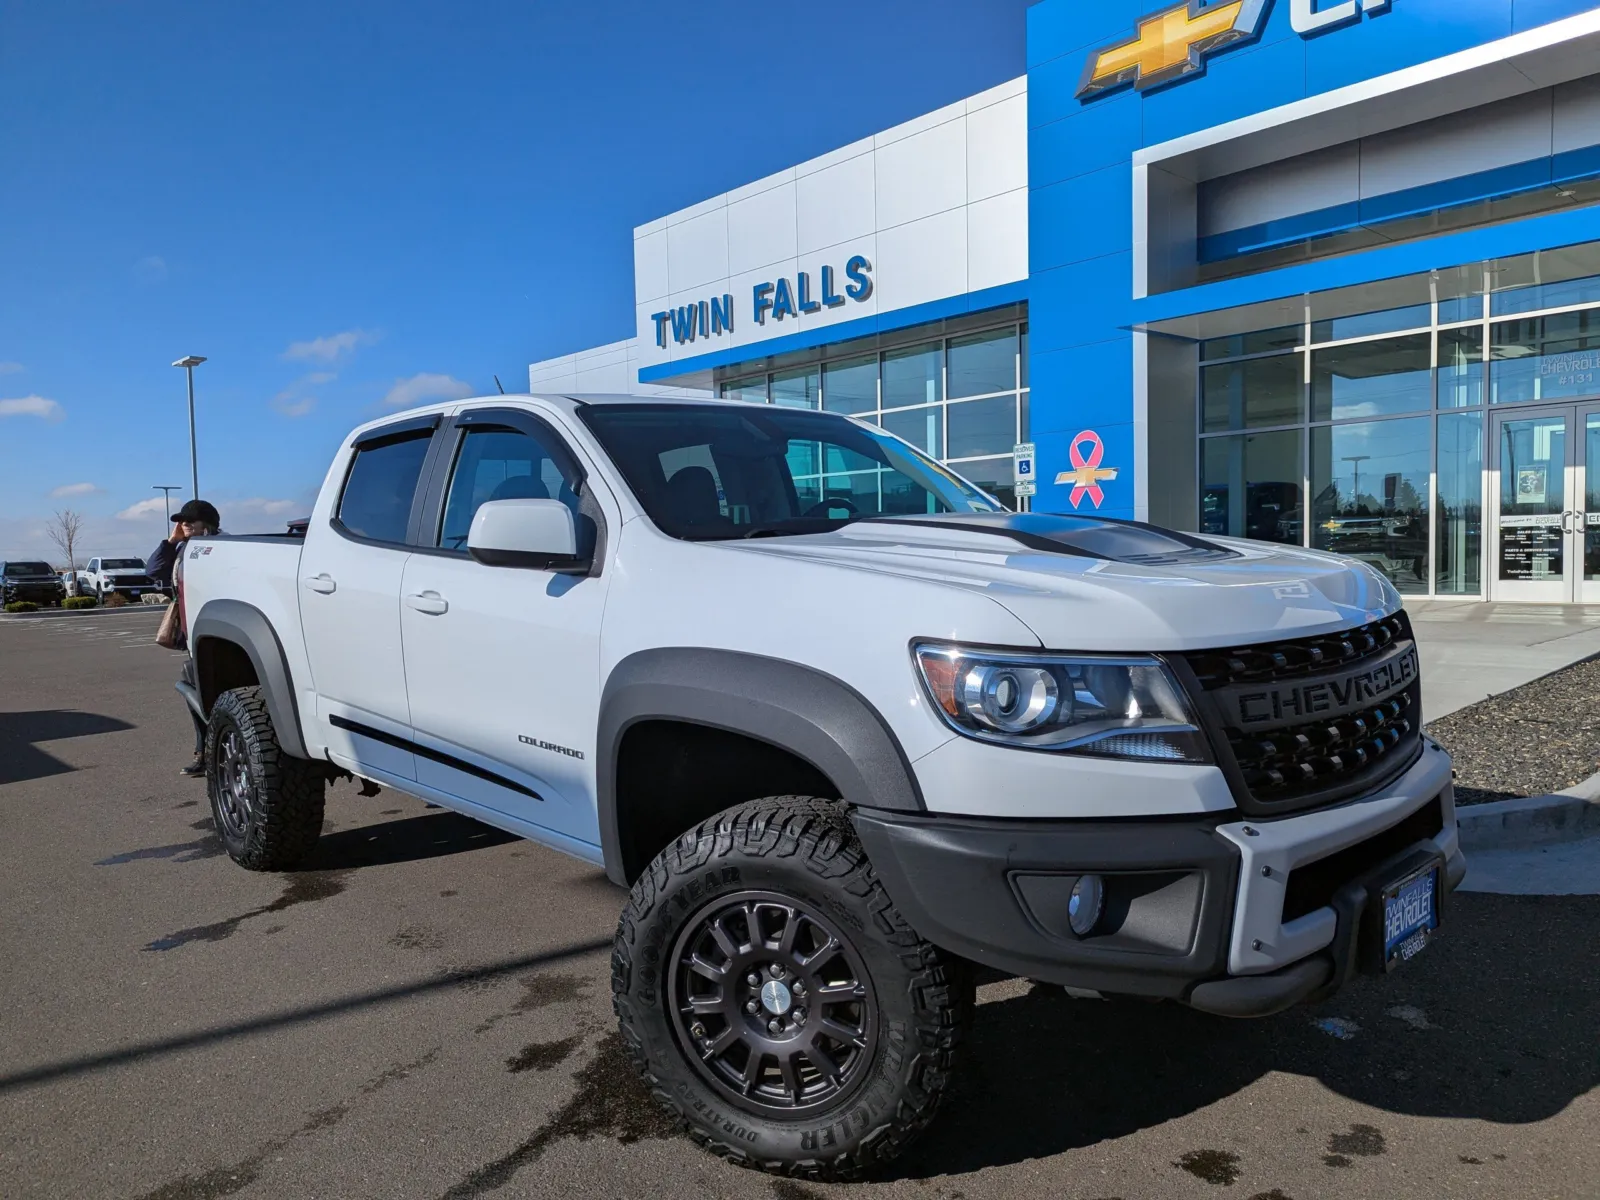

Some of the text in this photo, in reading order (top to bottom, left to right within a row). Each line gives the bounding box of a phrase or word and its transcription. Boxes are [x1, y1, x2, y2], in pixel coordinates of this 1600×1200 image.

[651, 255, 873, 349] TWIN FALLS
[1559, 373, 1593, 385] #131
[1238, 649, 1417, 724] CHEVROLET
[518, 734, 585, 760] COLORADO
[1401, 935, 1427, 960] CHEVROLET
[800, 1020, 906, 1150] WRANGLER
